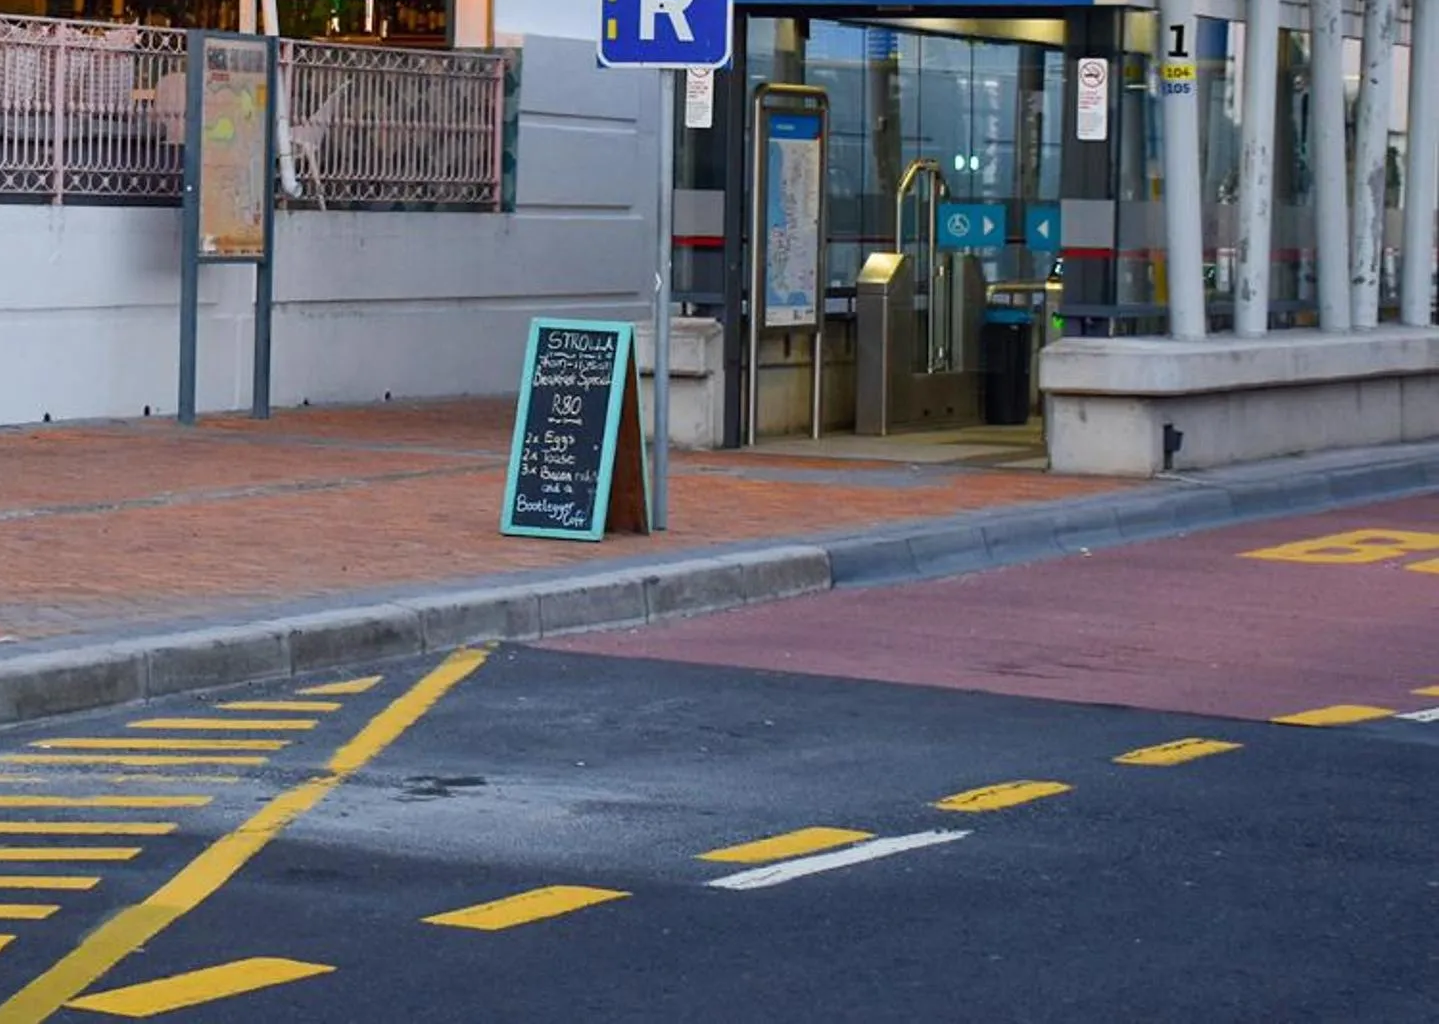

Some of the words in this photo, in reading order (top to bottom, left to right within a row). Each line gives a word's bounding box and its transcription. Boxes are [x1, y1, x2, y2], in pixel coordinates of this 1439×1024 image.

[1168, 24, 1188, 57] 1
[1167, 83, 1191, 94] 105
[544, 430, 575, 452] Eggs
